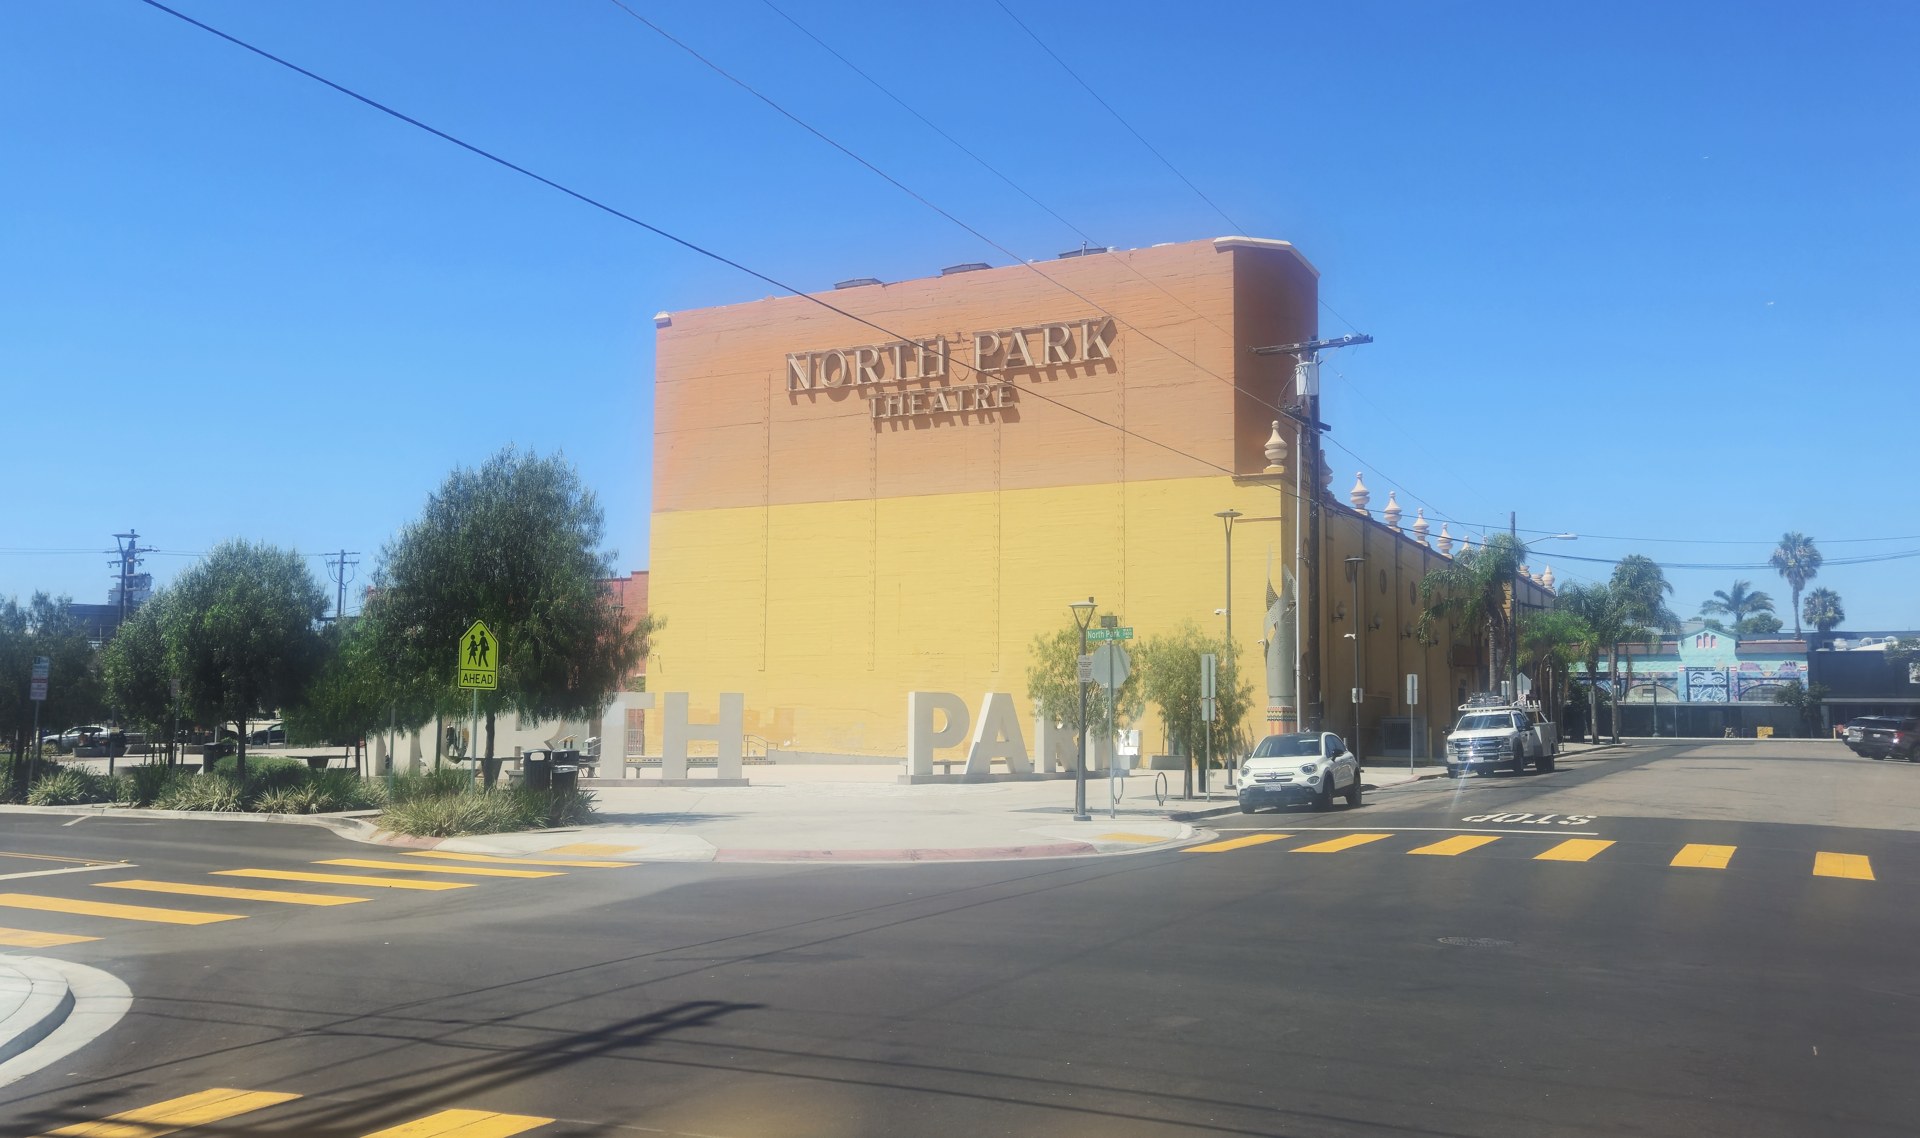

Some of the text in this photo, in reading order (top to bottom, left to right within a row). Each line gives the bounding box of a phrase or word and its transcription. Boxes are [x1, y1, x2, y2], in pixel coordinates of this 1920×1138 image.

[786, 315, 1113, 392] NORTH PARK
[868, 381, 1015, 418] THEATRE
[1087, 630, 1104, 639] North
[1105, 629, 1120, 638] Park
[462, 673, 494, 685] AHEAD
[1461, 812, 1597, 825] STOP
